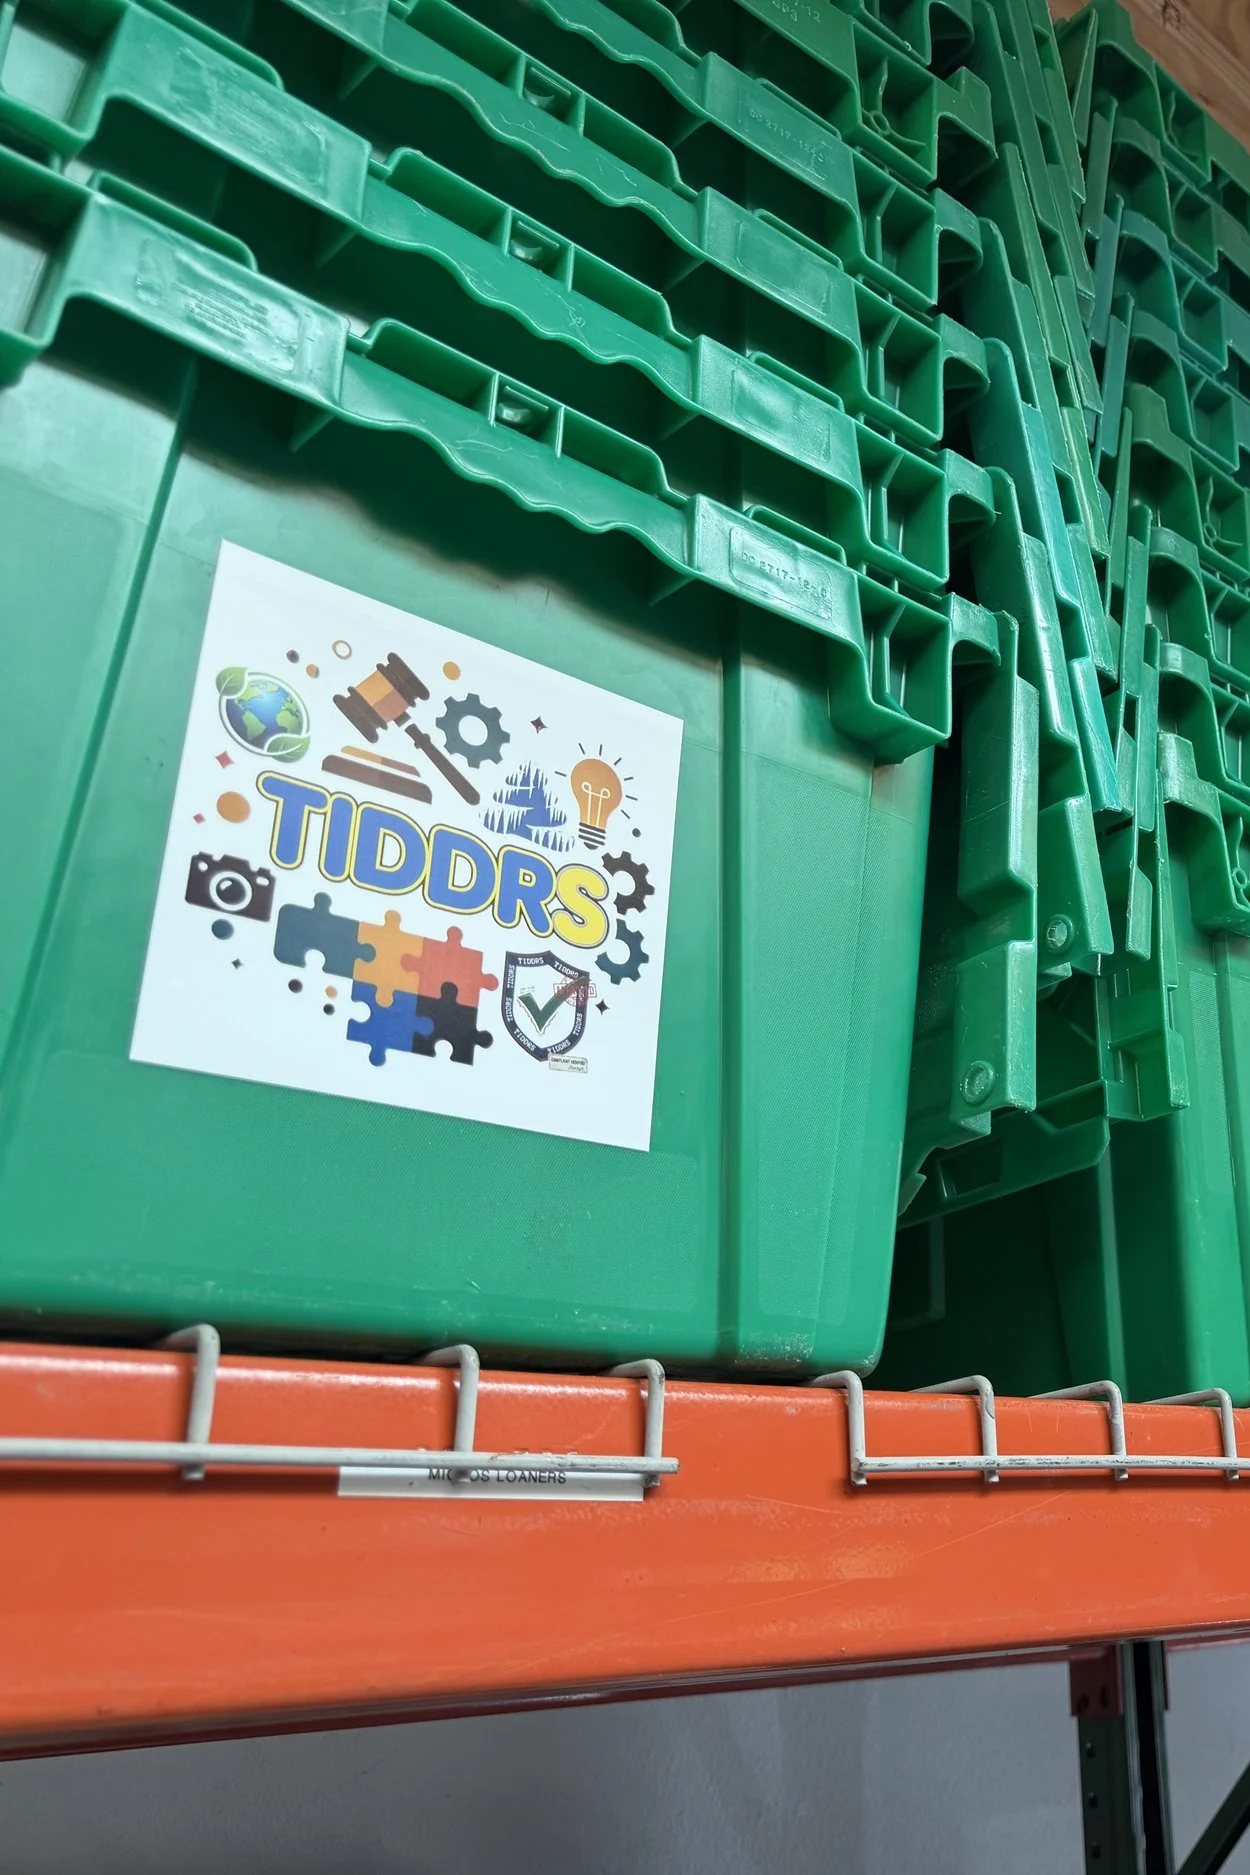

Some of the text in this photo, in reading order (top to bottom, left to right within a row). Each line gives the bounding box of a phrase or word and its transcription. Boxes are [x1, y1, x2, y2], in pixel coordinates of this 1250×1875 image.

[256, 770, 609, 949] TIDDRS
[518, 957, 544, 965] TIDDRS
[507, 964, 515, 988] TIDDRS
[514, 1028, 536, 1051] TIDDRS
[497, 1469, 567, 1484] LOANERS
